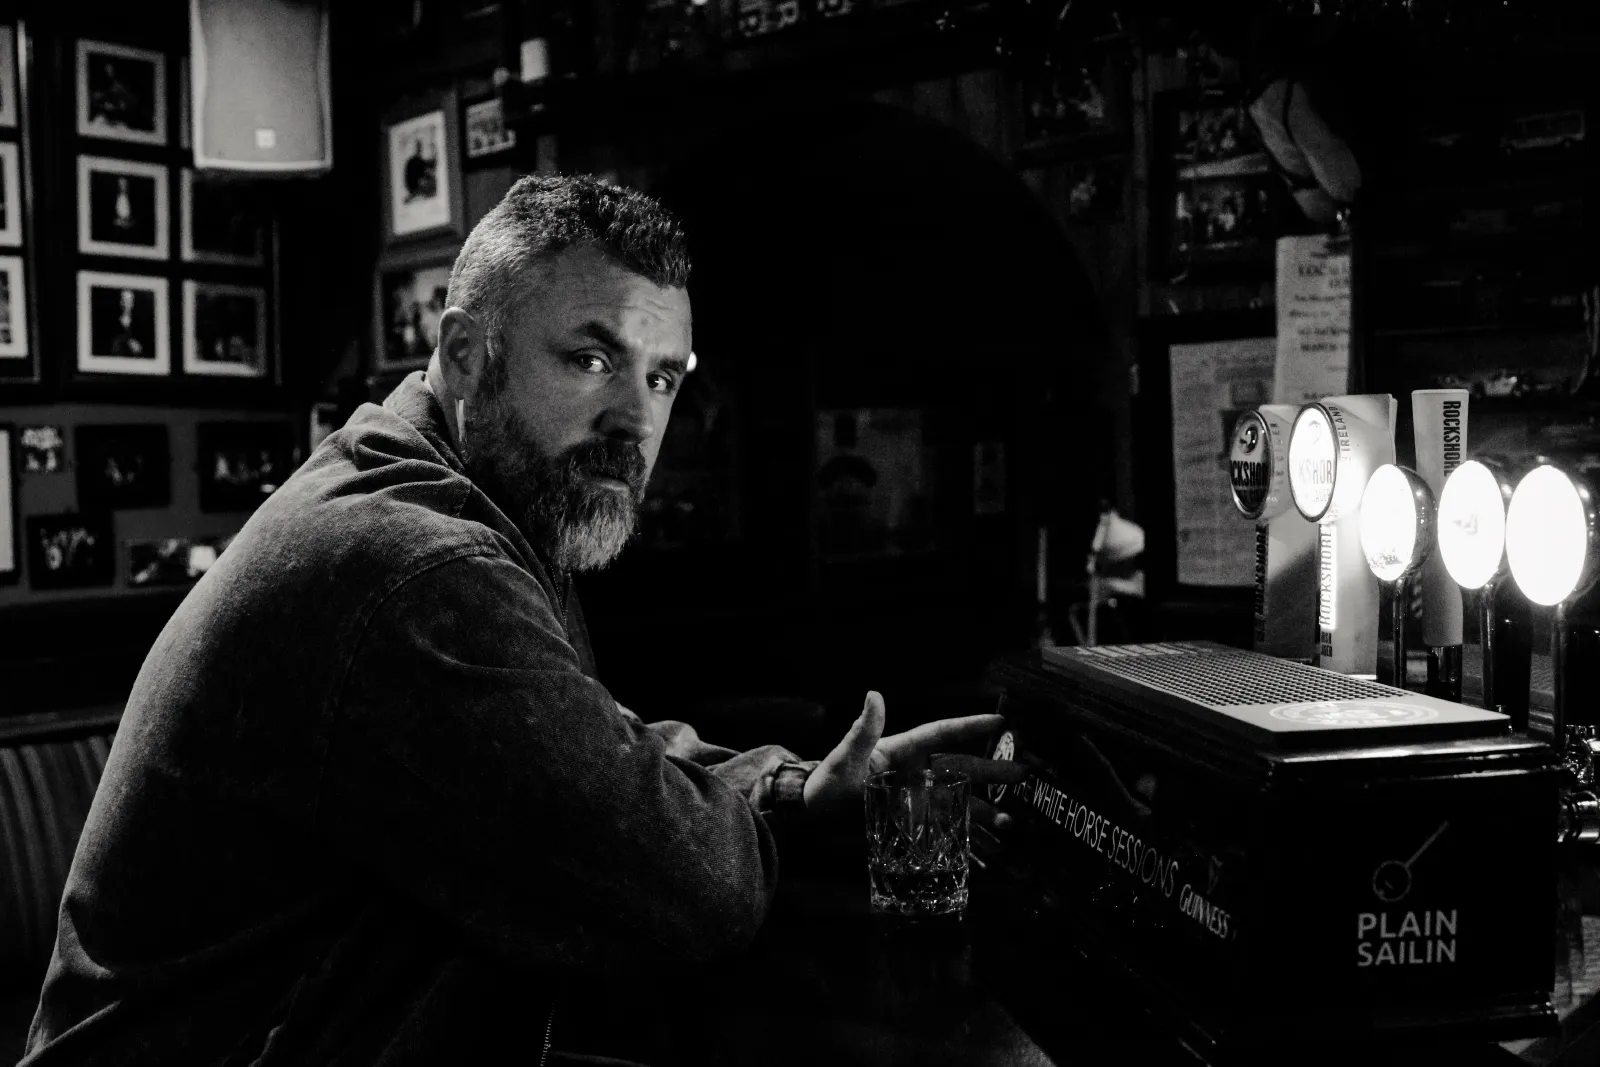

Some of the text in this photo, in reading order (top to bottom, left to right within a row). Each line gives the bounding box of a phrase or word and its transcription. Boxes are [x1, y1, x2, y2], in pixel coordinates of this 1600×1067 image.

[1329, 406, 1351, 452] IRELAND
[1319, 526, 1332, 625] ROCKSHORE
[1033, 778, 1068, 825] WHITE
[1065, 799, 1110, 853] HORSE
[1107, 826, 1179, 899] SESSIONS
[1179, 884, 1232, 939] GUINNESS
[1357, 908, 1458, 940] PLAIN
[1356, 938, 1457, 968] SAILIN
